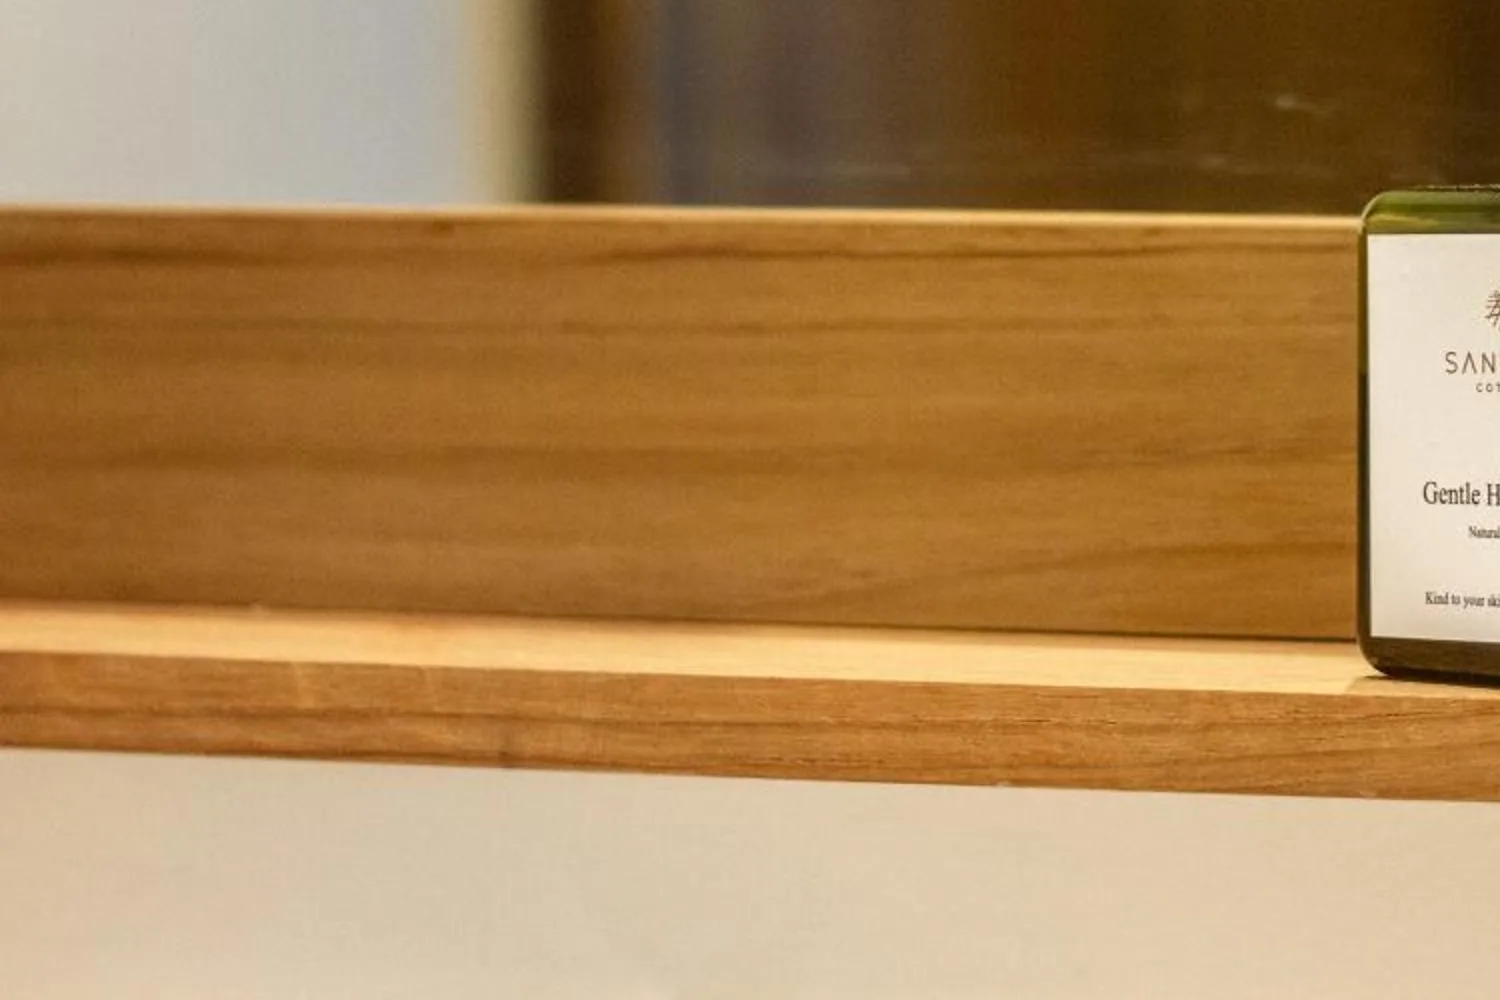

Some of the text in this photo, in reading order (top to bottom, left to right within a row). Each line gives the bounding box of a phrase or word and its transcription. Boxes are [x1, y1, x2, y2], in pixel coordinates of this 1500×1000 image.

[1423, 481, 1481, 505] Gentle
[1468, 526, 1500, 539] Natural
[1425, 592, 1449, 605] Kind
[1451, 594, 1461, 605] to
[1463, 596, 1485, 609] your
